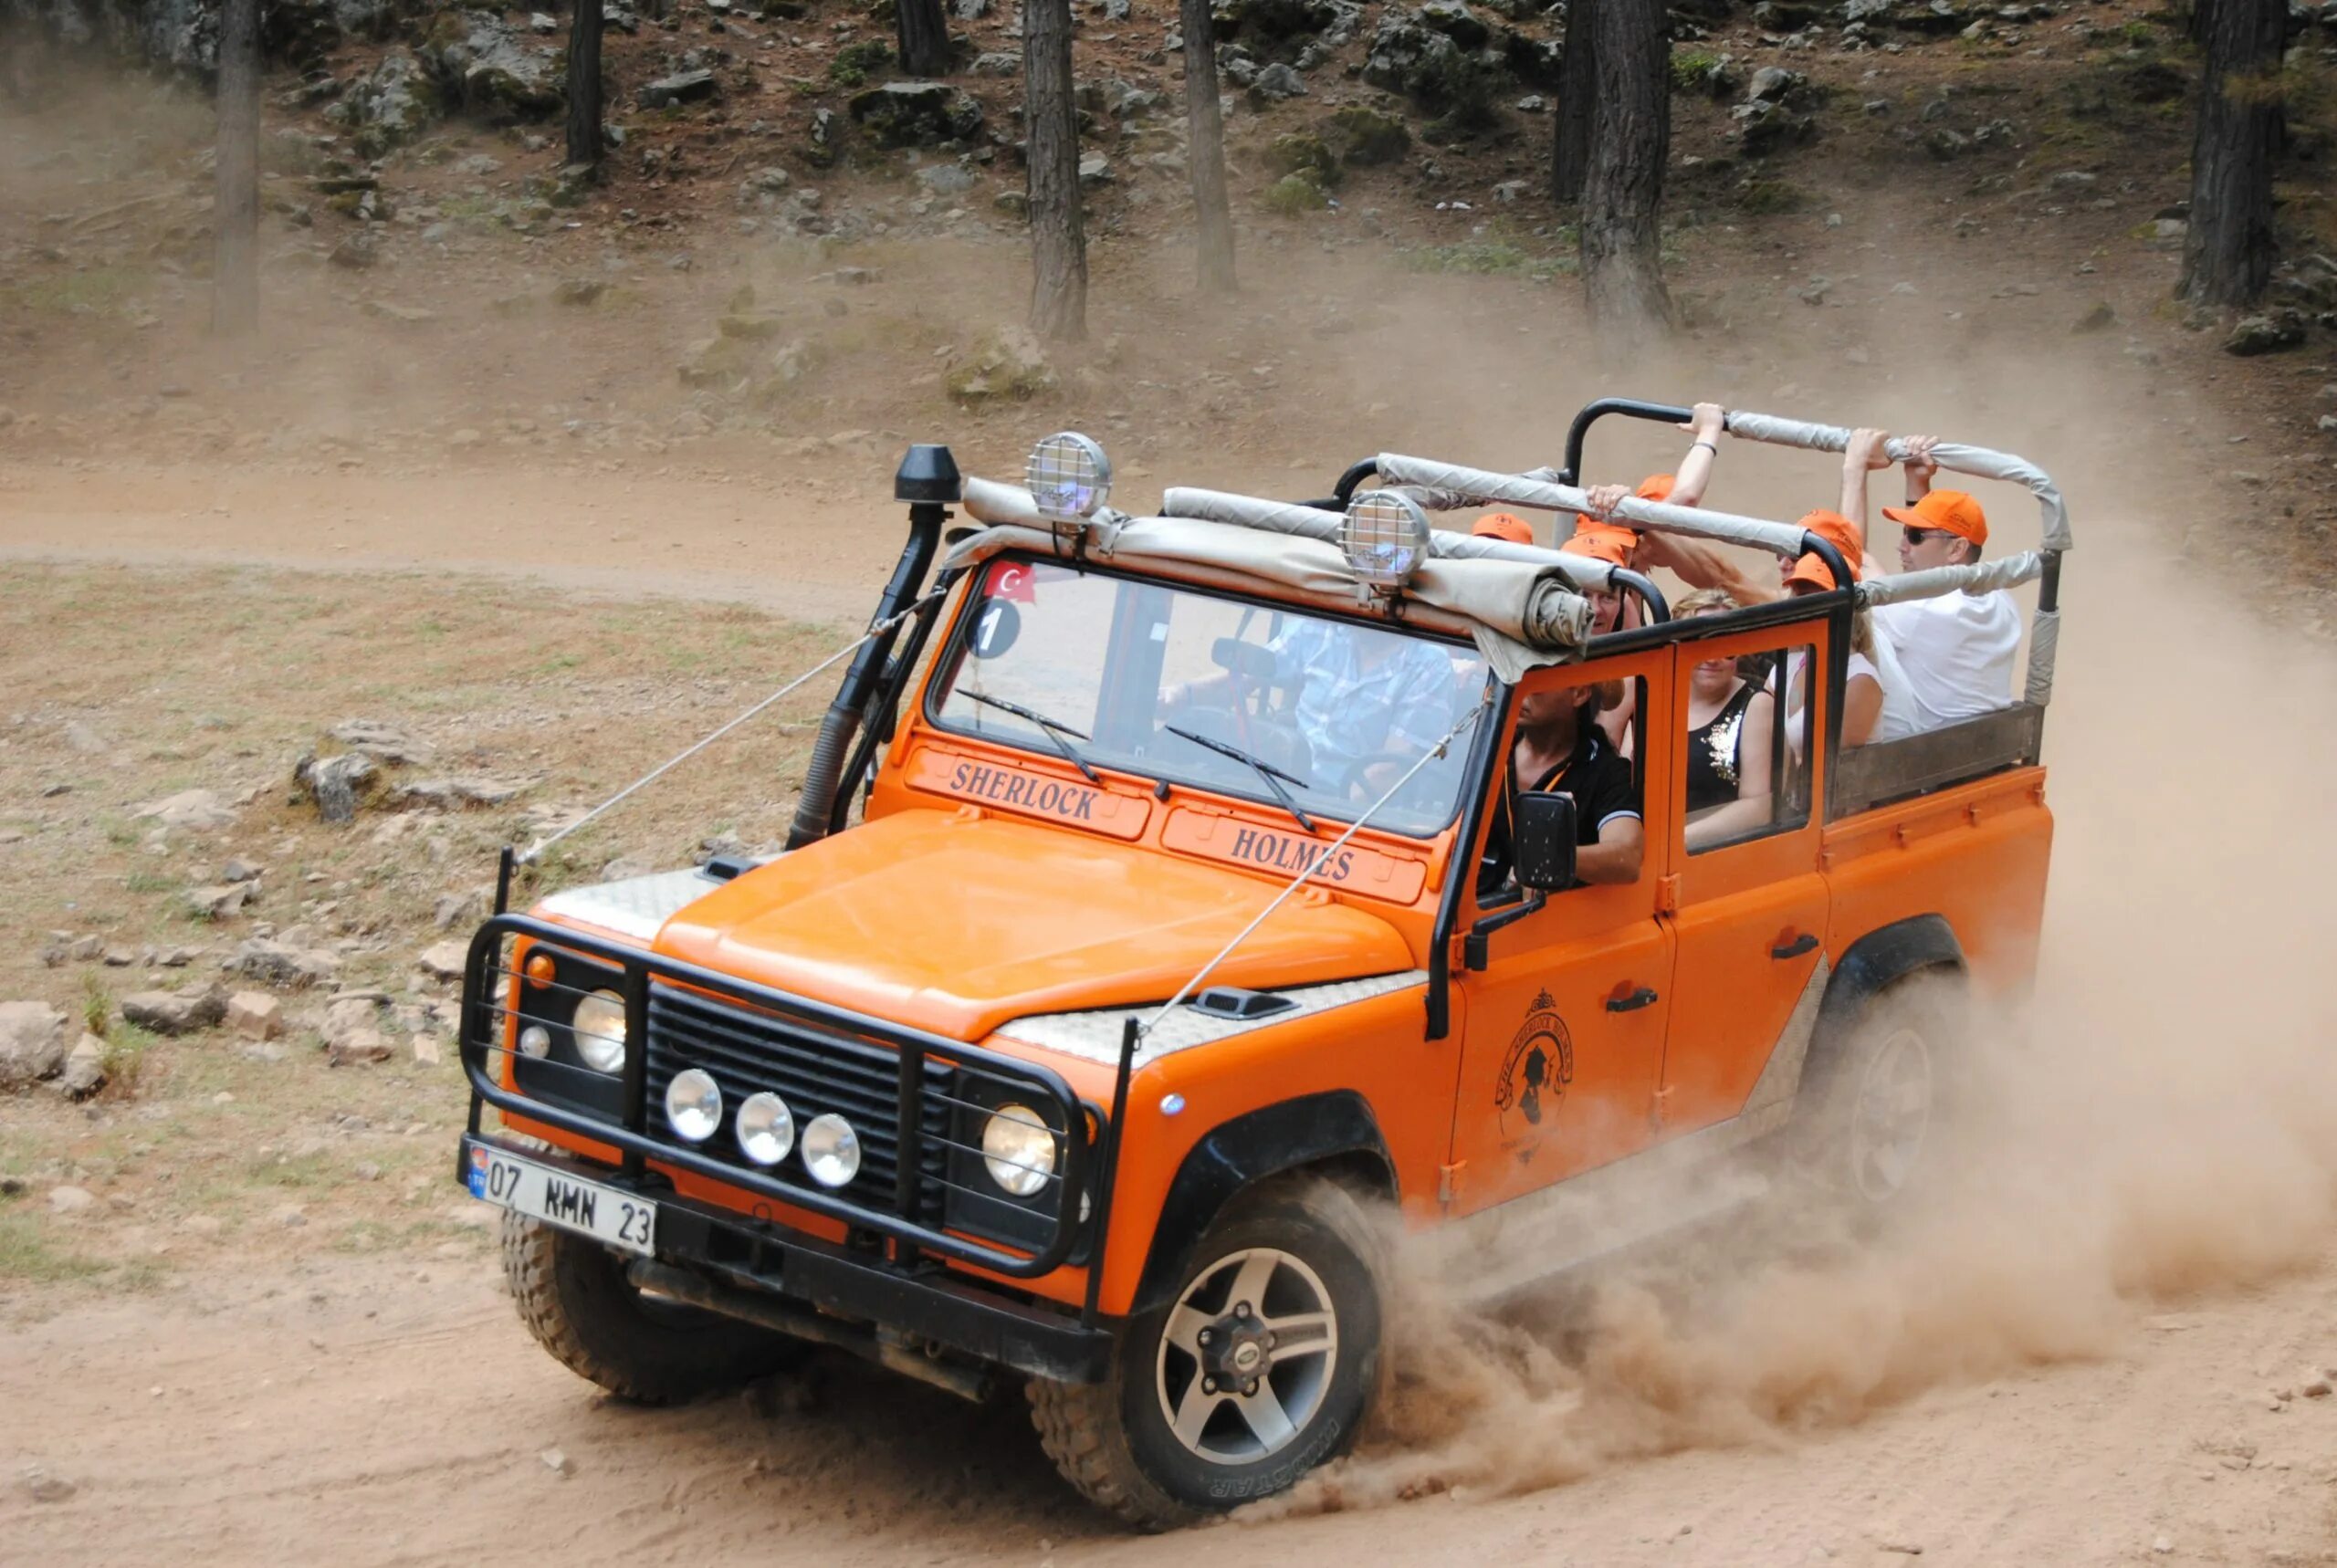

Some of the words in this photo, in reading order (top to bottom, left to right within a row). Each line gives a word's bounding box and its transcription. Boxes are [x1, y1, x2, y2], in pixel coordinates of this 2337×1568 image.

[980, 607, 1002, 651] 1
[949, 762, 1098, 821] SHERLOCK
[1231, 828, 1356, 881] HOLMES
[489, 1161, 522, 1201] 07
[544, 1176, 597, 1229] NMN
[618, 1201, 652, 1246] 23
